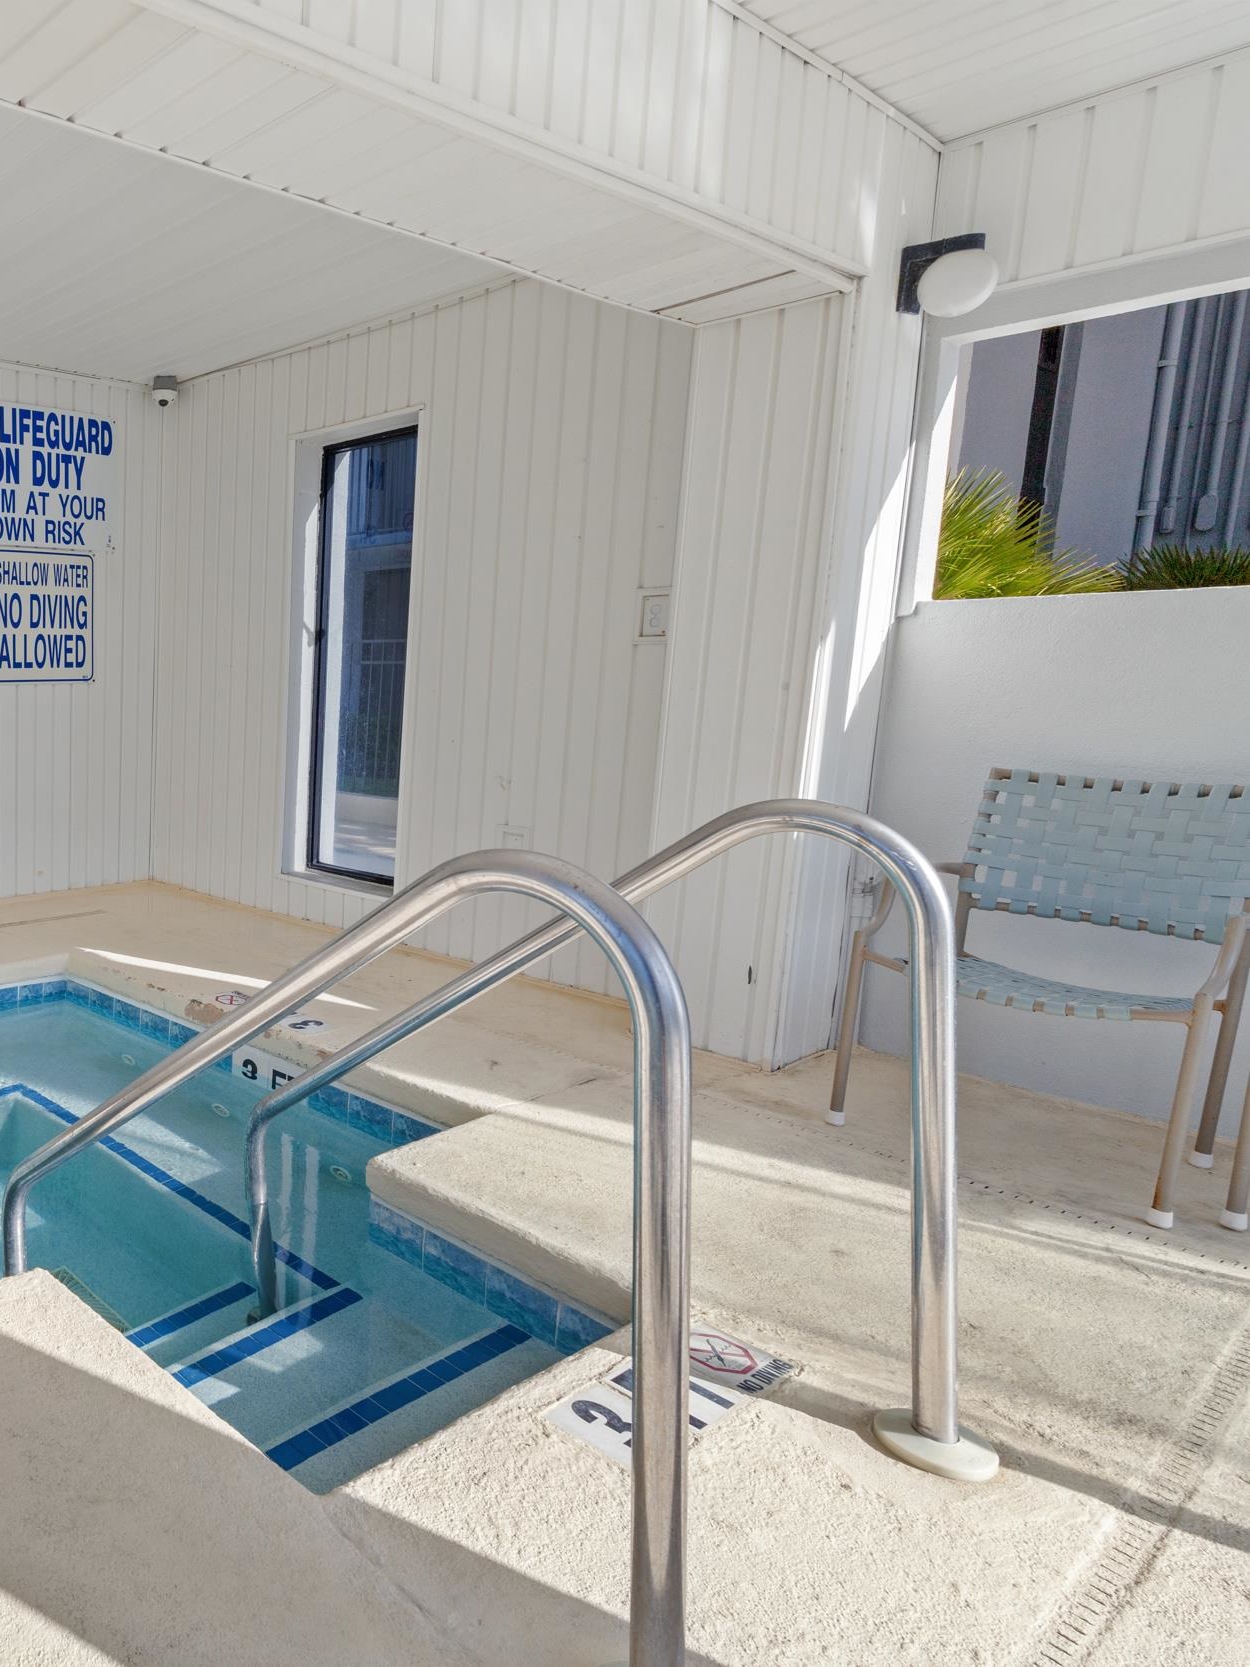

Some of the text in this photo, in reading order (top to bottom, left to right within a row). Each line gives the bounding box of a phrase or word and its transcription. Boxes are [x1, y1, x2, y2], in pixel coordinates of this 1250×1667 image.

[0, 406, 113, 456] LIFEGUARD
[32, 450, 85, 490] DUTY
[26, 491, 49, 516] AT
[58, 494, 106, 521] YOUR
[45, 520, 85, 545] RISK
[53, 564, 88, 588] WATER
[30, 594, 87, 630] DIVING
[288, 1020, 324, 1030] 3
[241, 1059, 294, 1090] 3 F
[737, 1359, 795, 1394] NO DIVING
